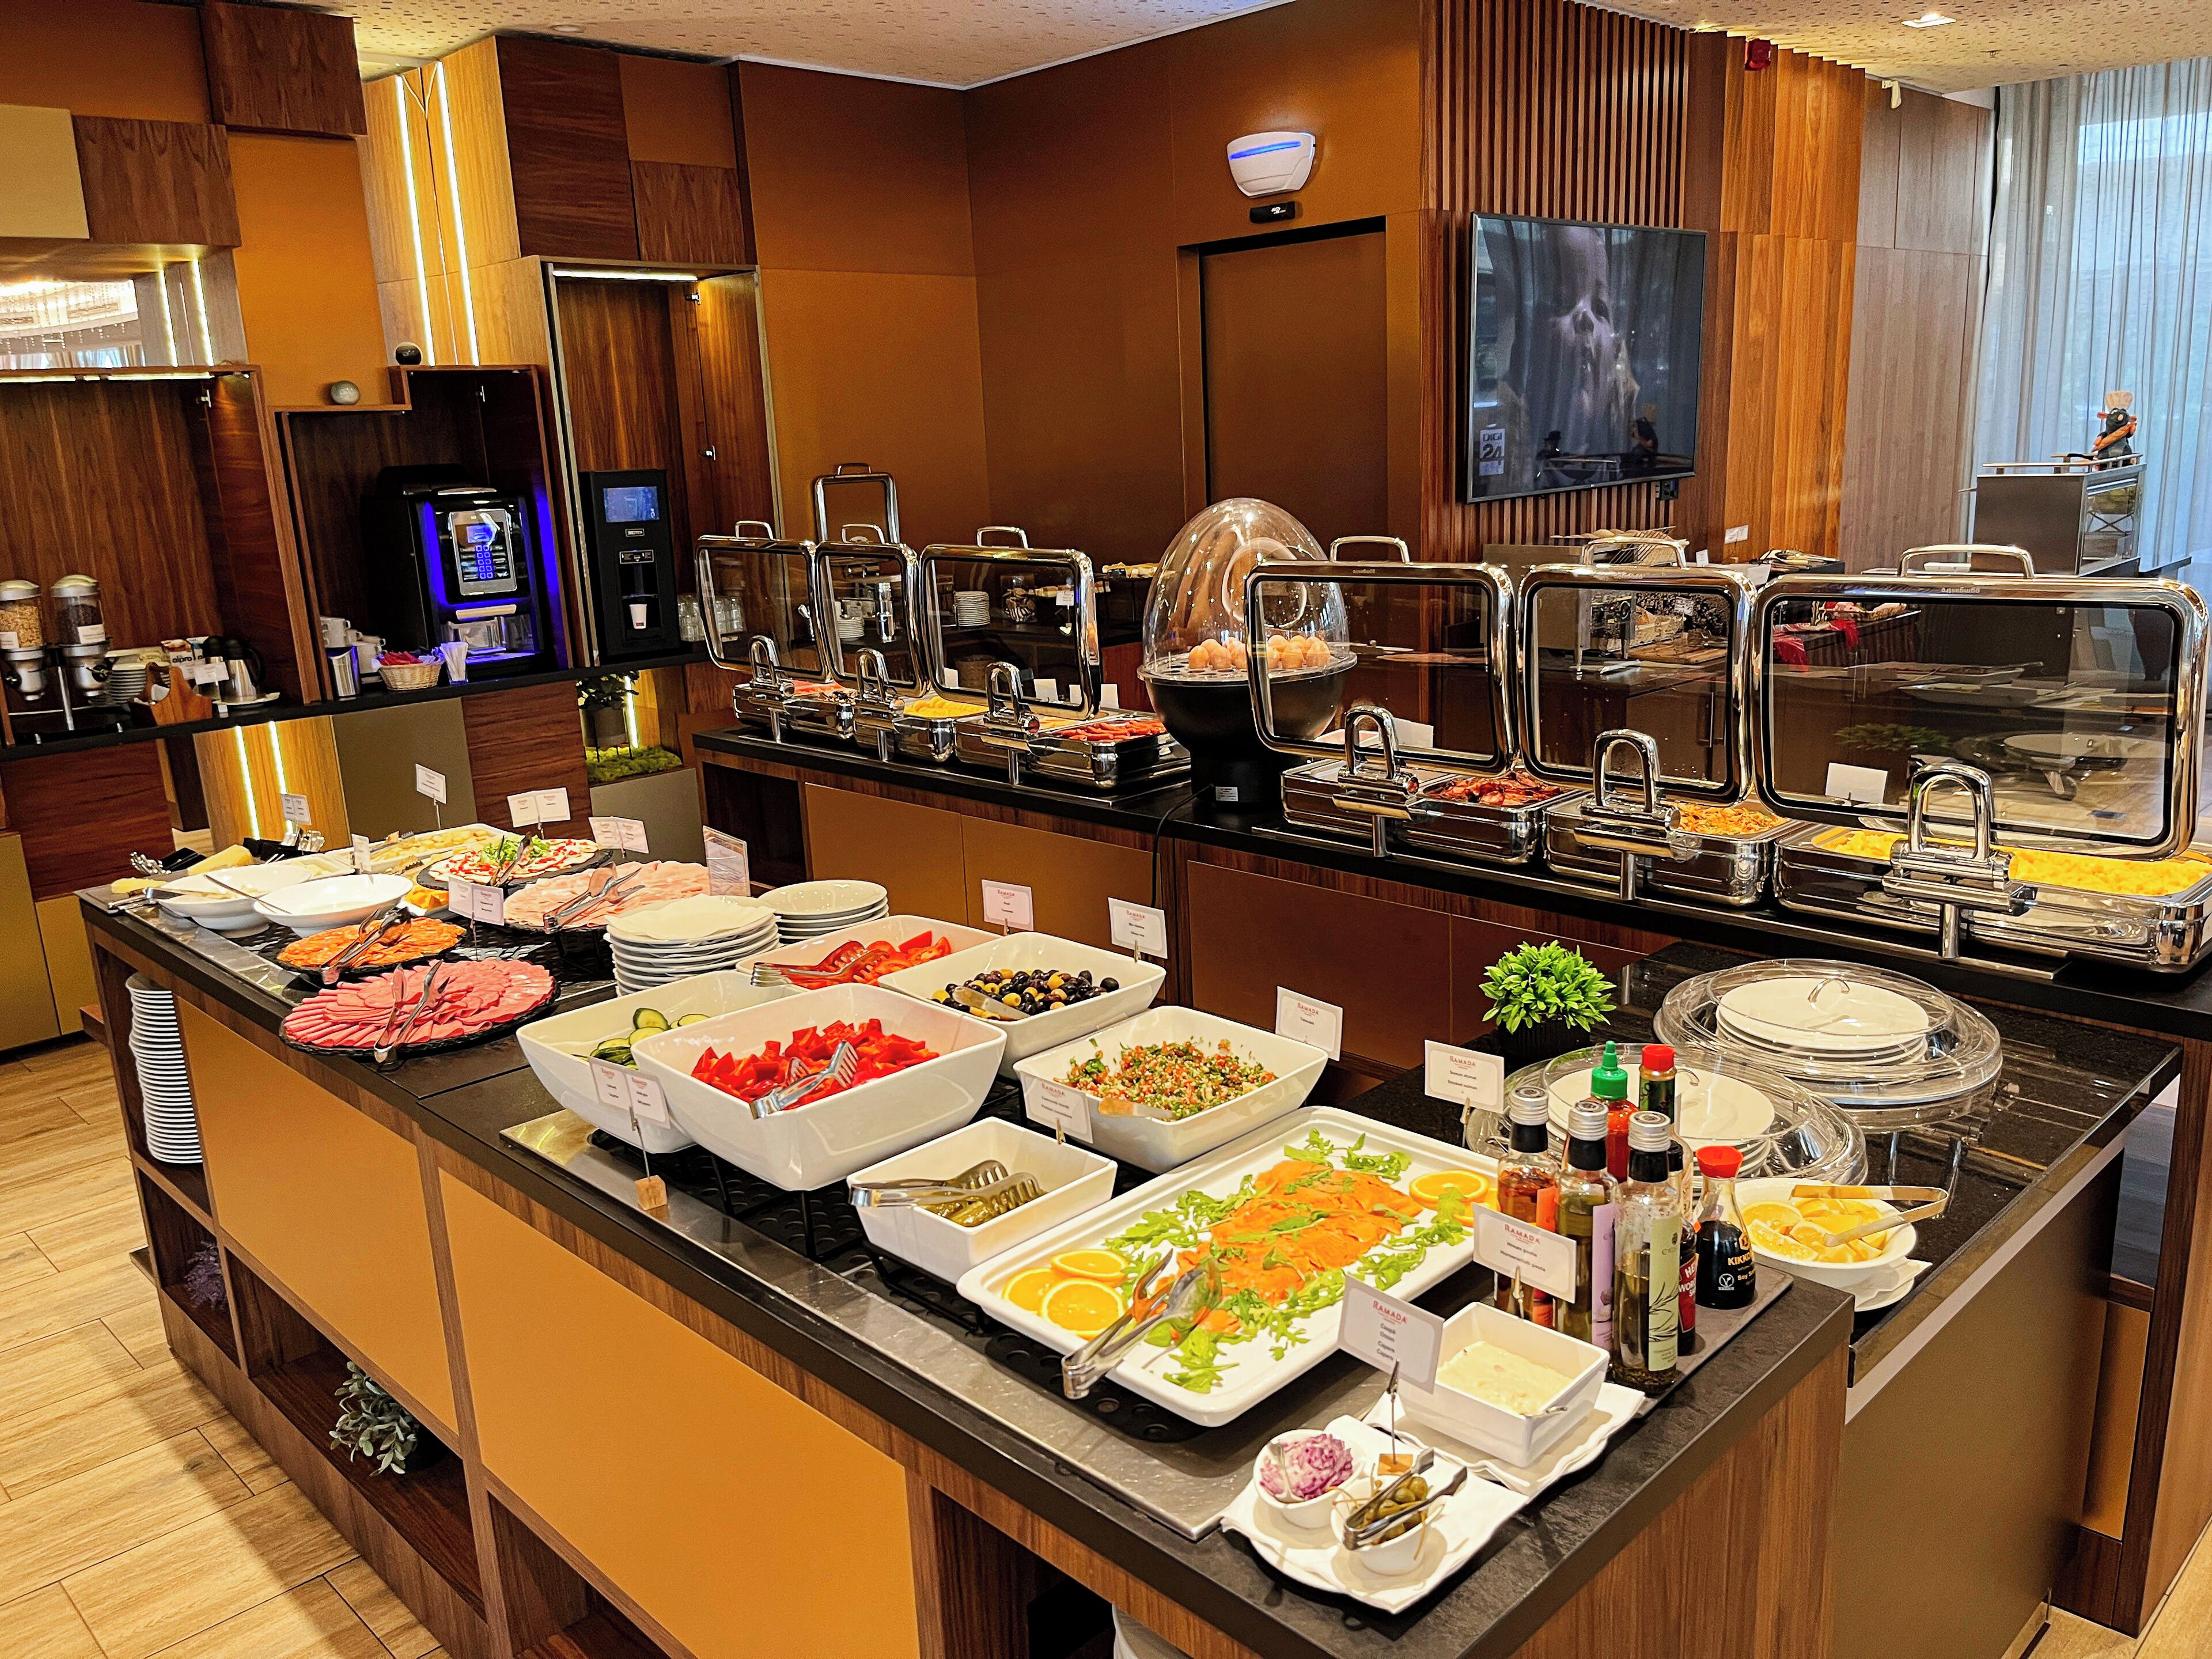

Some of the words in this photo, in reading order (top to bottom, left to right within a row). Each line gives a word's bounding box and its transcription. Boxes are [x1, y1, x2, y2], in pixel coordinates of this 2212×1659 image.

[1483, 433, 1502, 442] DIGI
[1482, 444, 1502, 465] 24
[1297, 1002, 1319, 1015] RAMADA
[1450, 1055, 1475, 1067] RAMADA
[1504, 1224, 1540, 1244] RAMADA
[1728, 1252, 1752, 1266] KIKKO
[1685, 1263, 1695, 1278] HE
[1373, 1301, 1406, 1324] RAMADA
